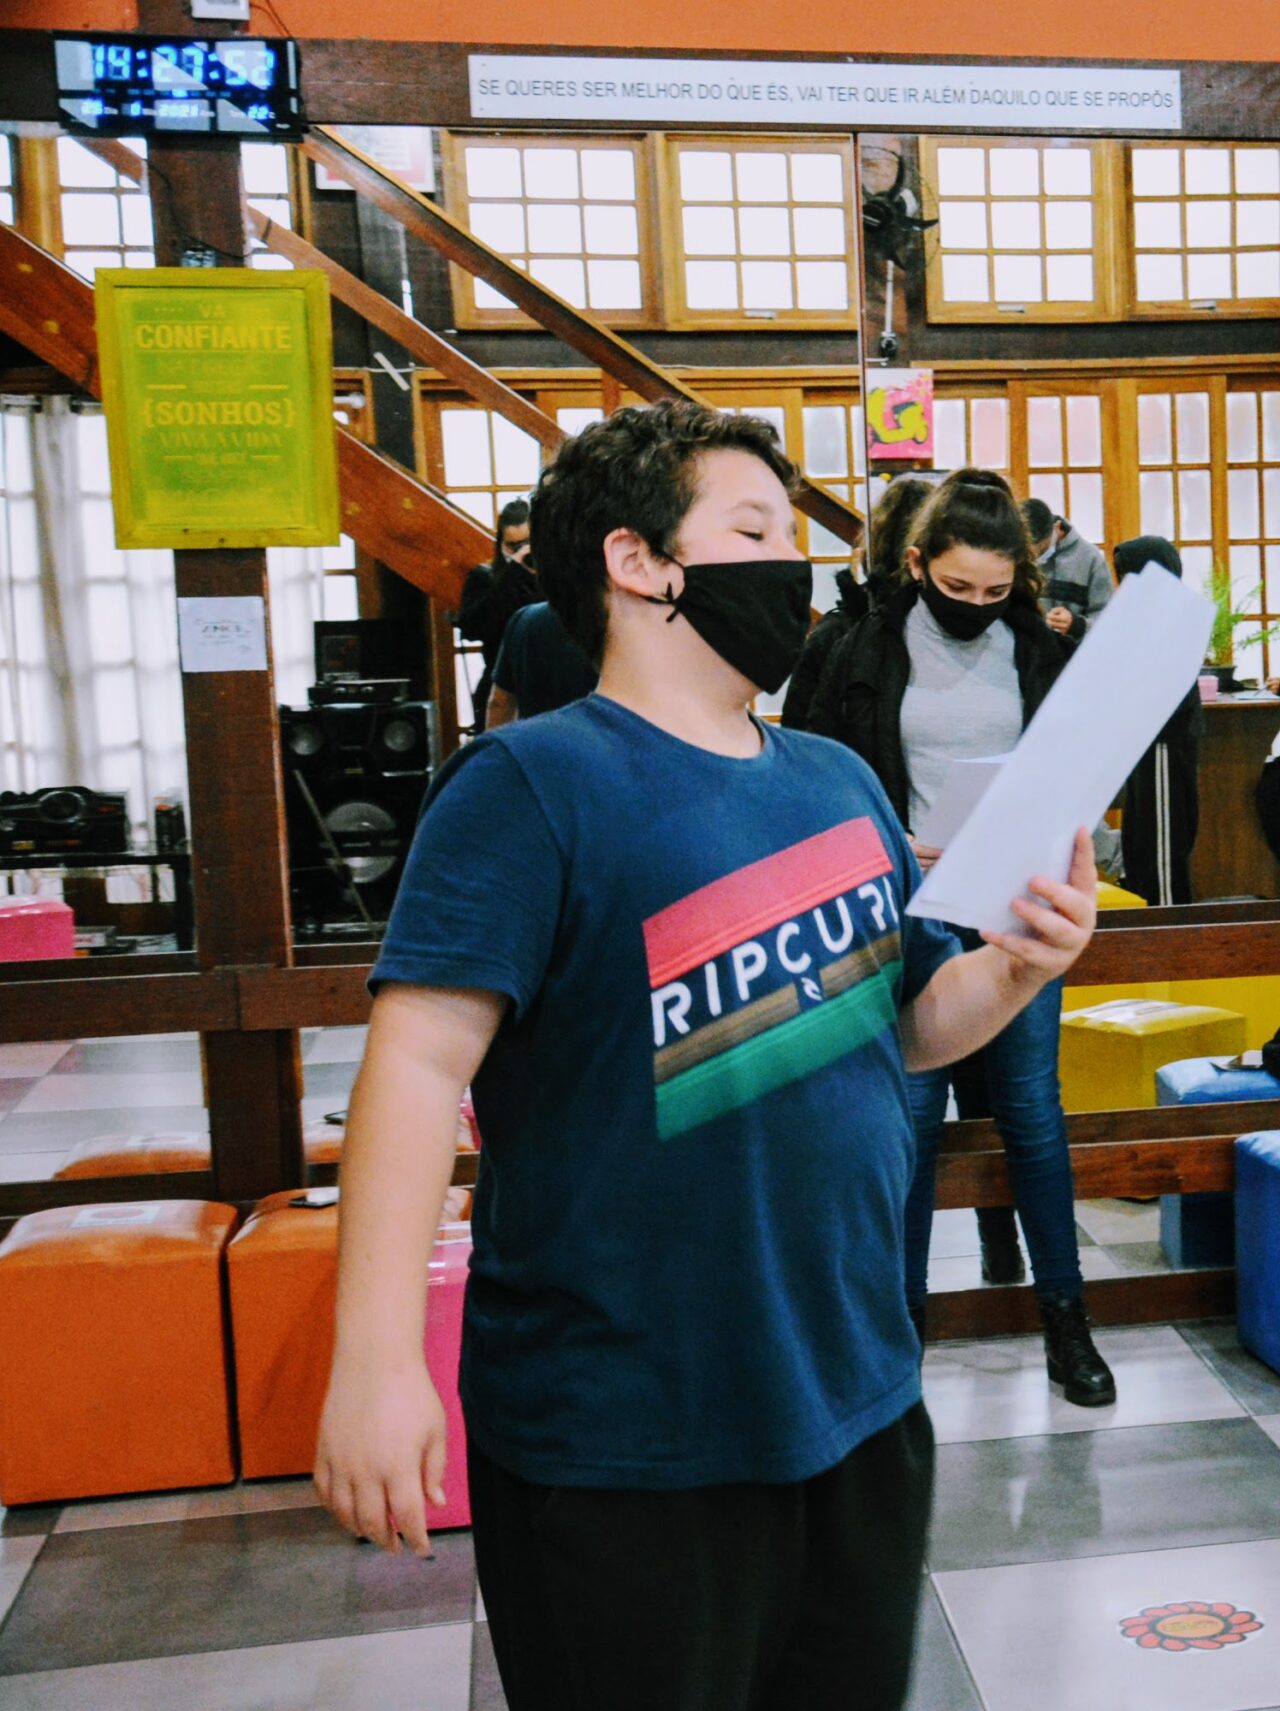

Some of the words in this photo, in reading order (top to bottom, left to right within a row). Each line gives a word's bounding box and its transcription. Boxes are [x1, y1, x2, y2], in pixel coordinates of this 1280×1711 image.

[478, 79, 500, 96] SE
[505, 80, 577, 97] QUERES
[583, 81, 618, 98] SER
[622, 82, 693, 99] MELHOR
[699, 83, 723, 100] DO
[726, 84, 760, 101] QUE
[766, 80, 794, 102] ÉS,
[797, 85, 823, 101] VAI
[828, 86, 859, 102] TER
[863, 87, 897, 104] QUE
[903, 88, 919, 103] IR
[923, 85, 966, 105] ALÉM
[970, 89, 1041, 107] DAQUILO
[1045, 90, 1078, 107] QUE
[1083, 91, 1104, 107] SE
[1108, 88, 1174, 108] PROPÔS
[136, 324, 292, 349] CONFIANTE
